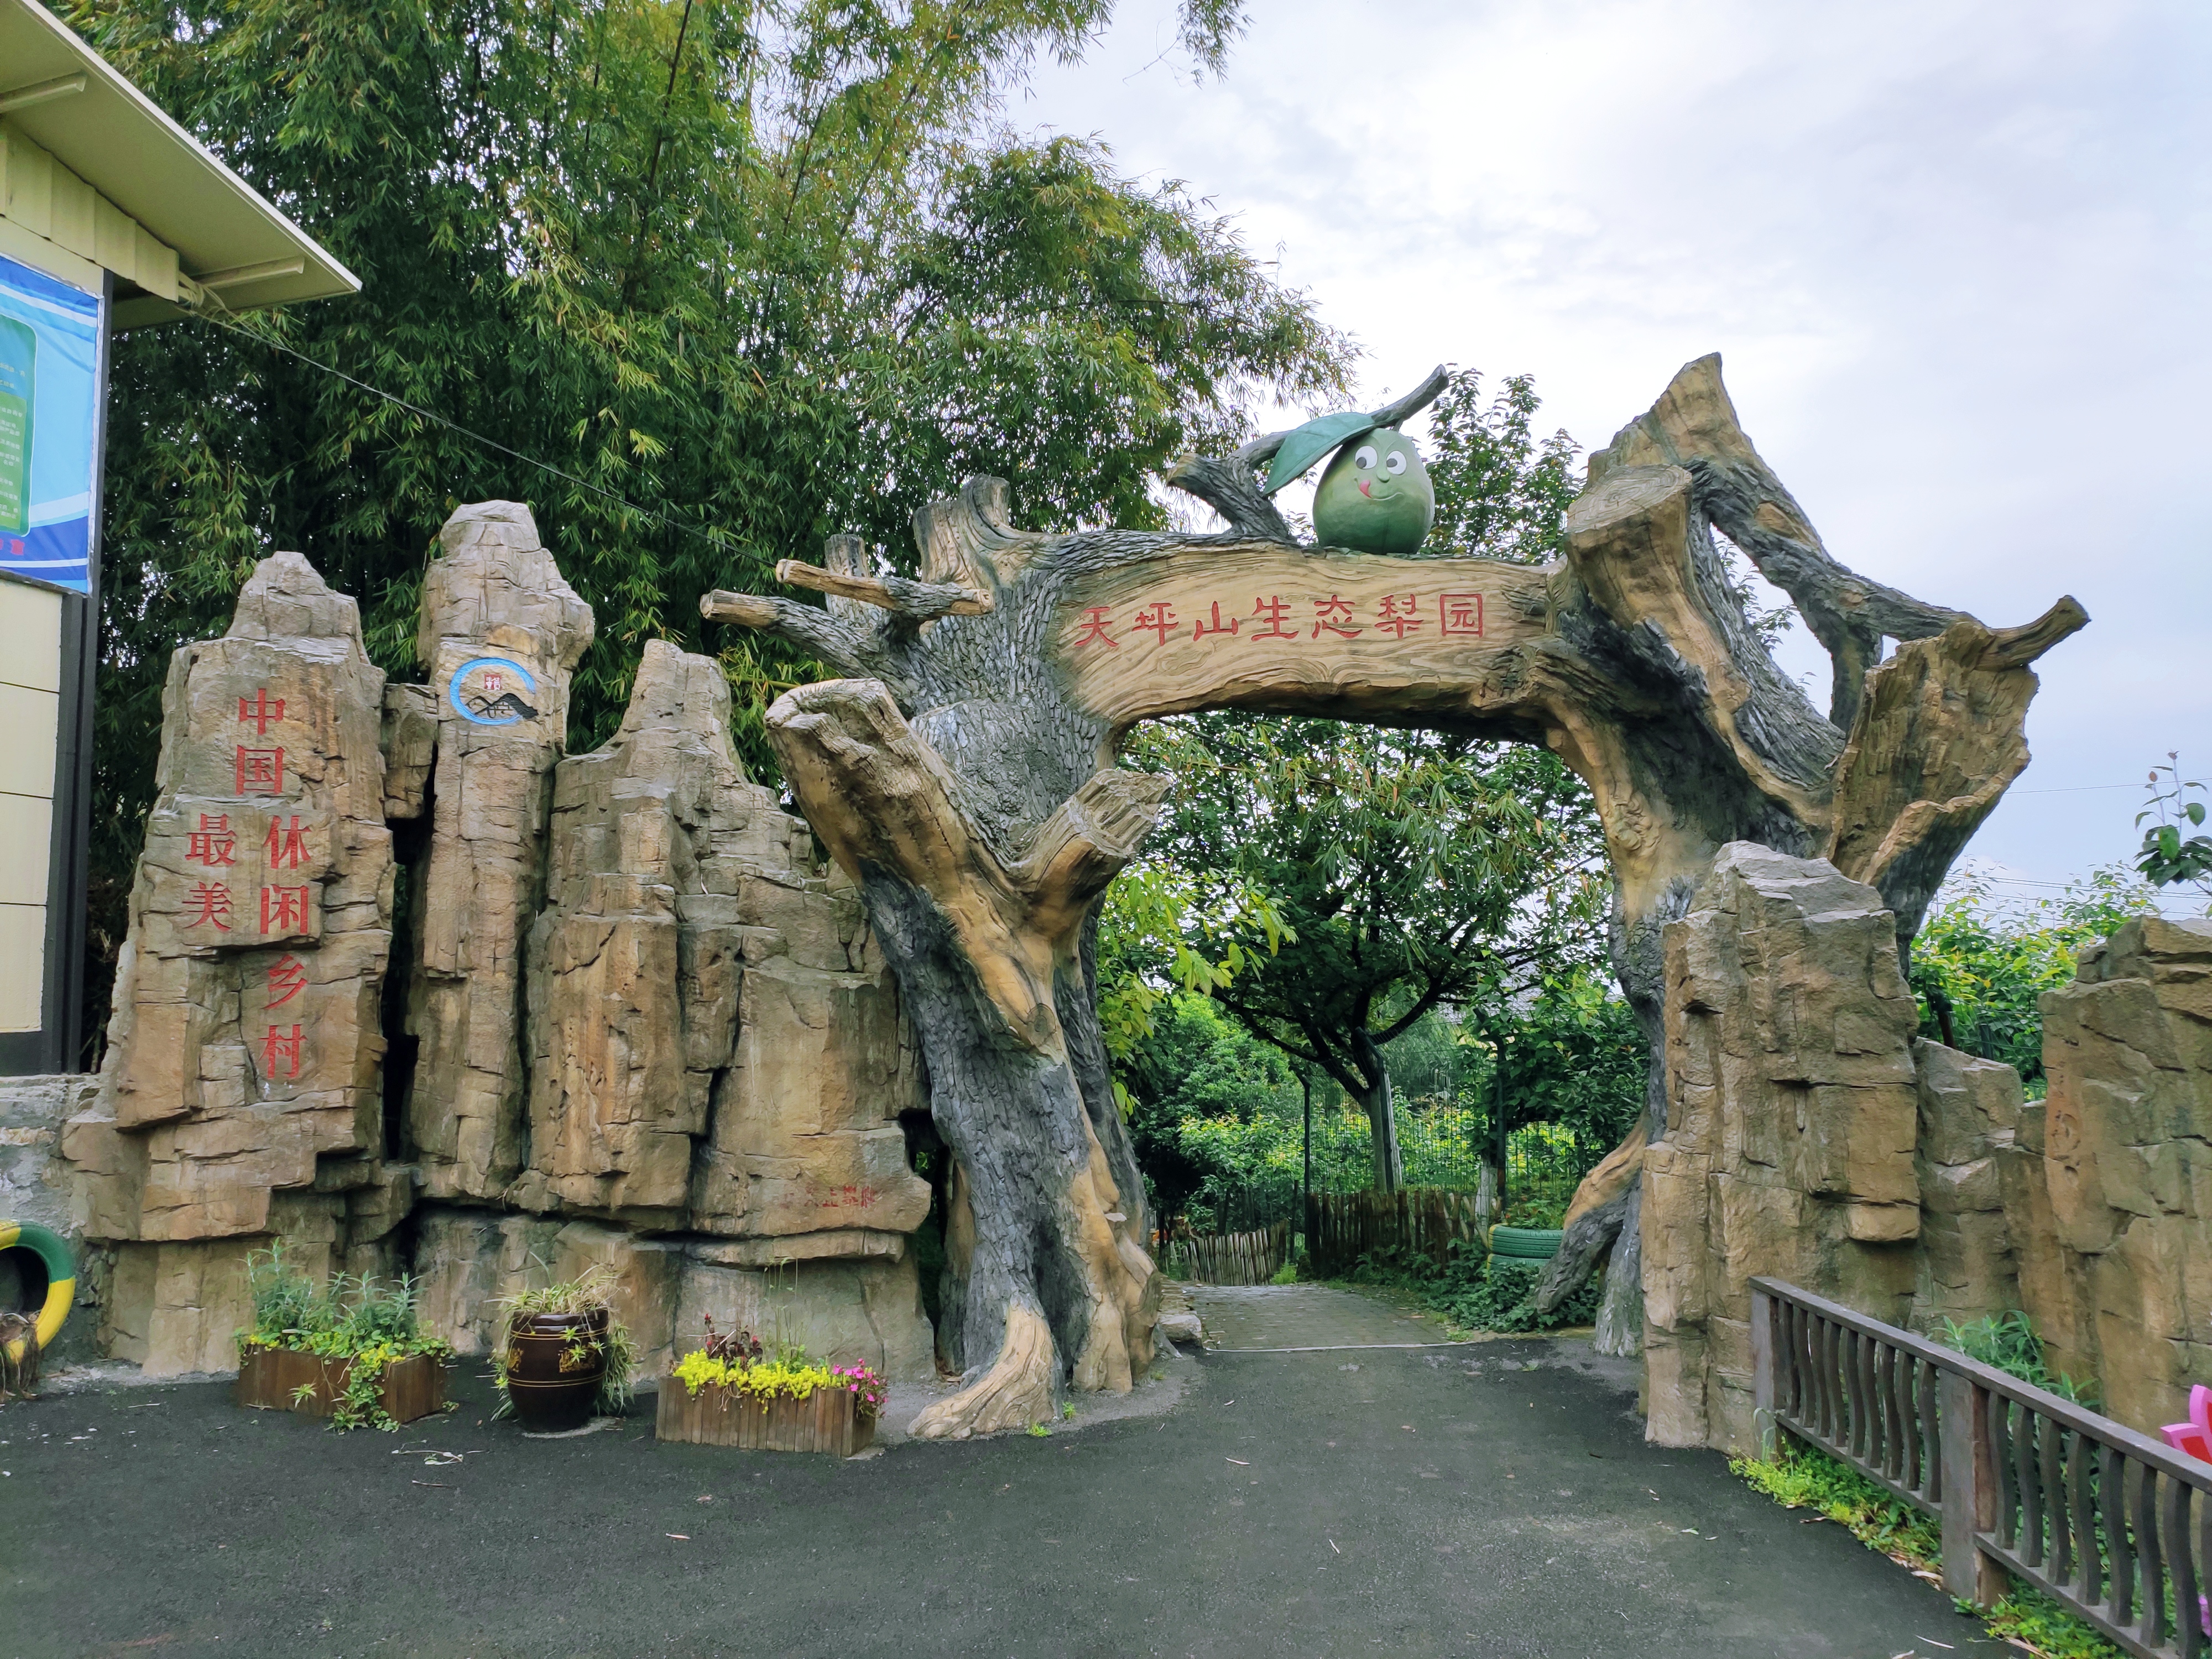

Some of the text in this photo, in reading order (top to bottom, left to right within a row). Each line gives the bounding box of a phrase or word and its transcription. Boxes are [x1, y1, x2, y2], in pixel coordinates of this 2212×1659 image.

[1074, 594, 1483, 648] 天坪山生态梨园
[236, 688, 286, 795] 中国
[182, 813, 237, 932] 最美
[259, 816, 311, 1079] 休闲乡村
